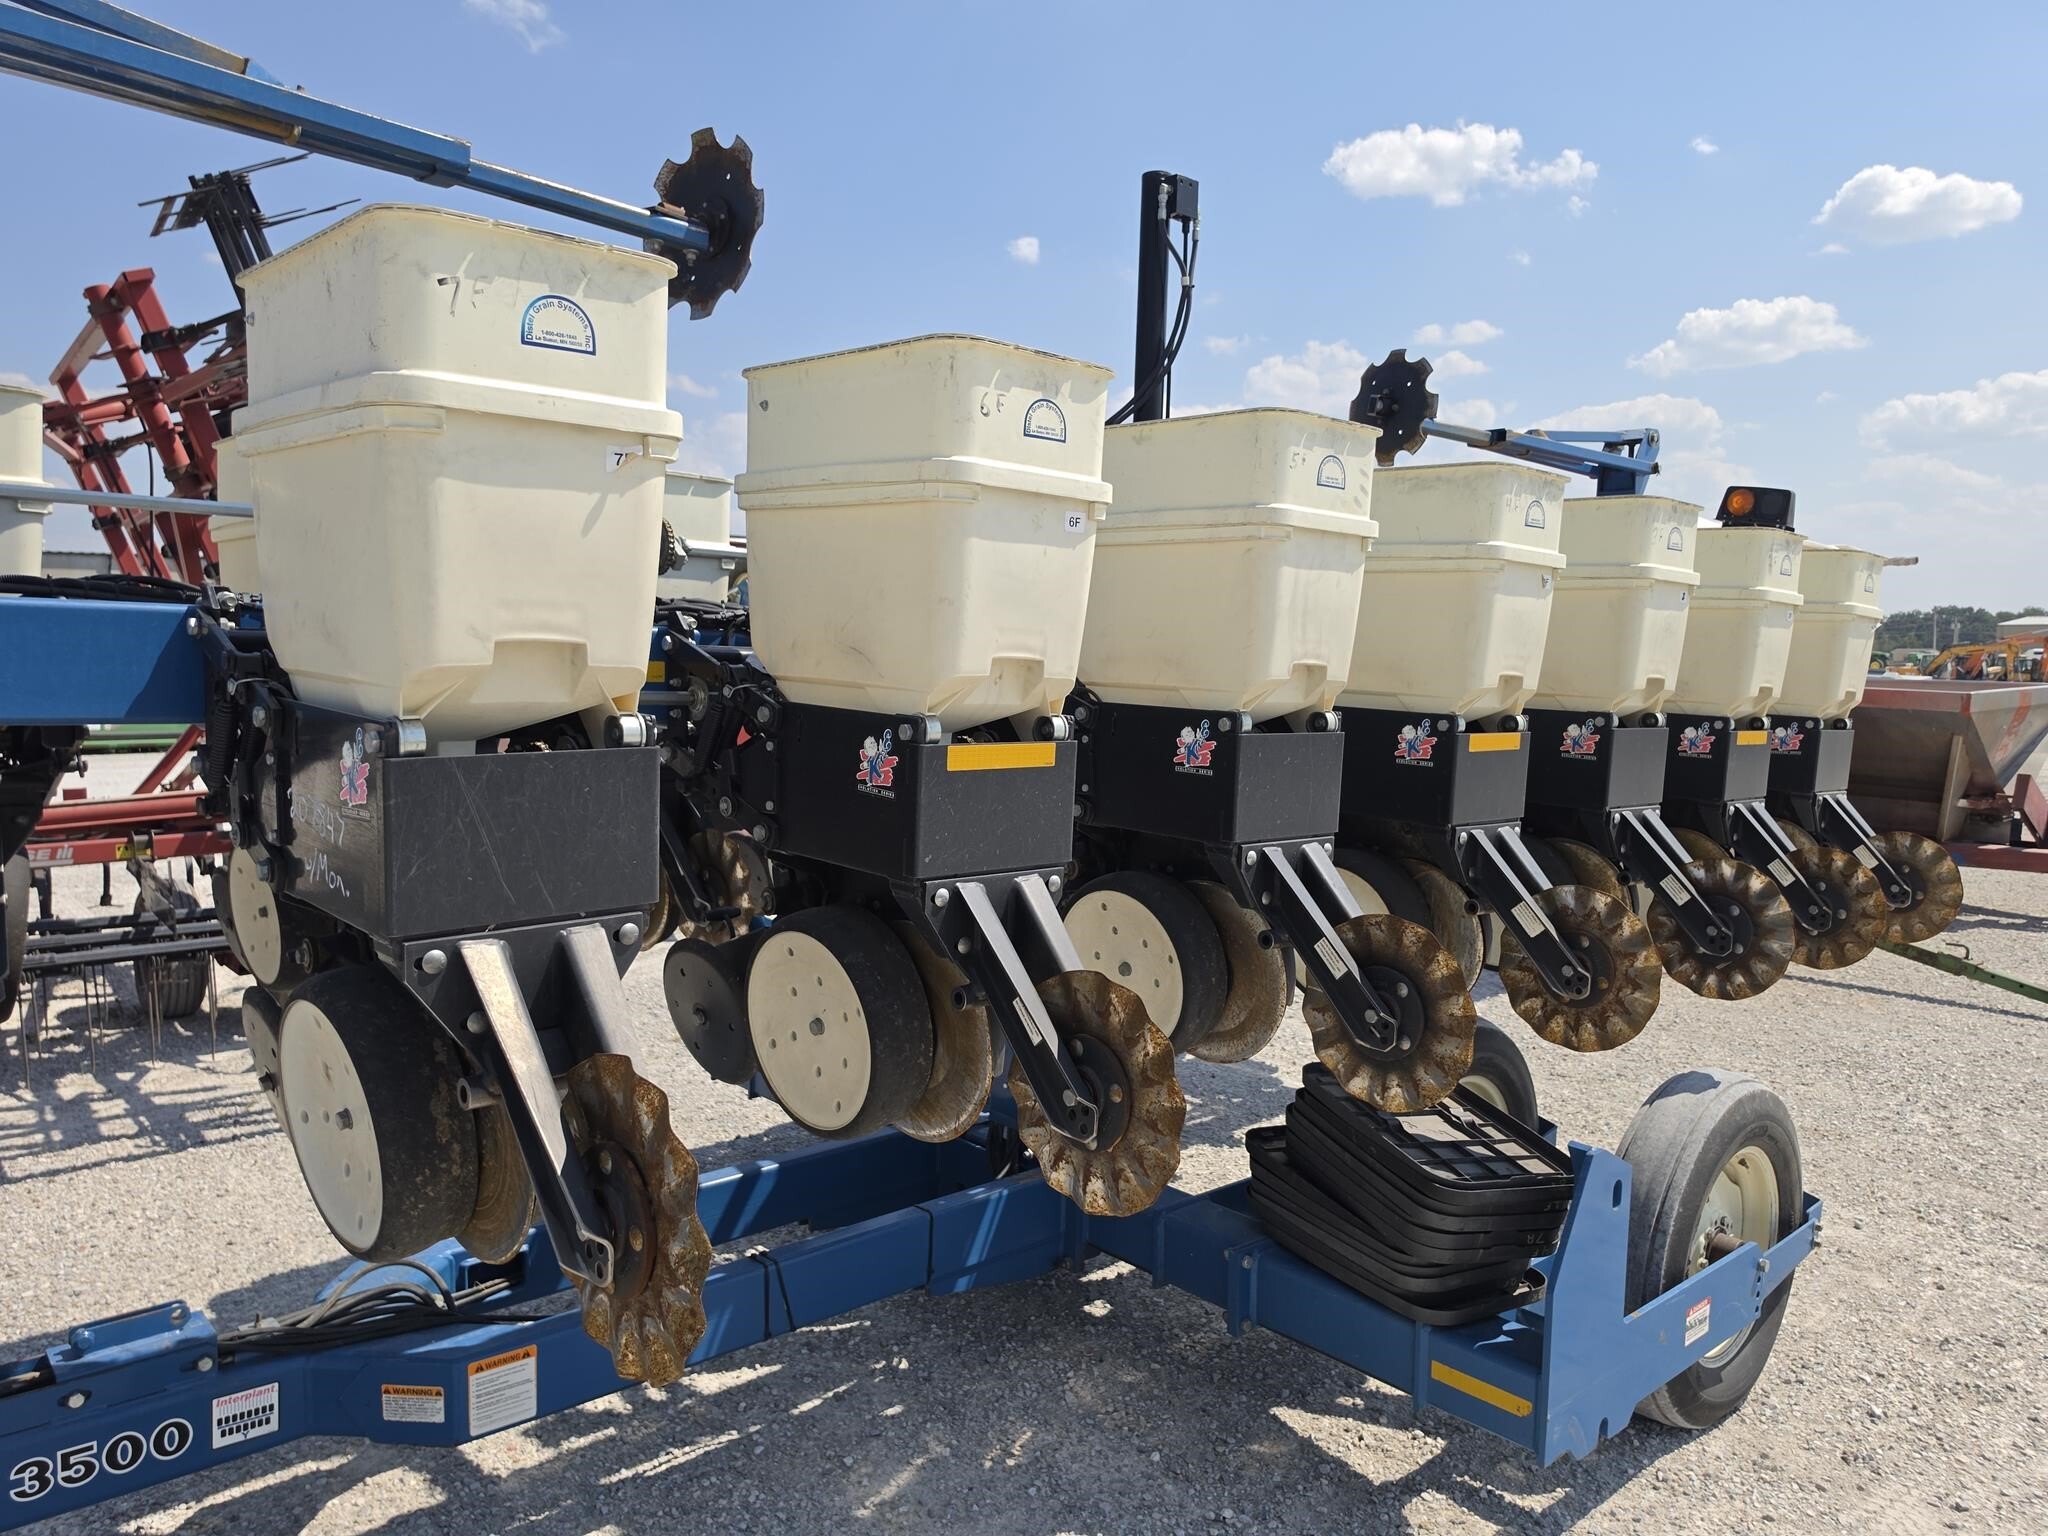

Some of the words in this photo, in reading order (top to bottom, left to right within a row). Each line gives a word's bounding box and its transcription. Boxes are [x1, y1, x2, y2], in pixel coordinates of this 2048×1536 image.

[525, 313, 536, 341] Distel
[532, 300, 555, 314] Grain
[1069, 516, 1081, 528] 6F
[485, 1353, 521, 1370] WARNING
[392, 1386, 433, 1397] WARNING
[9, 1417, 194, 1502] 3500
